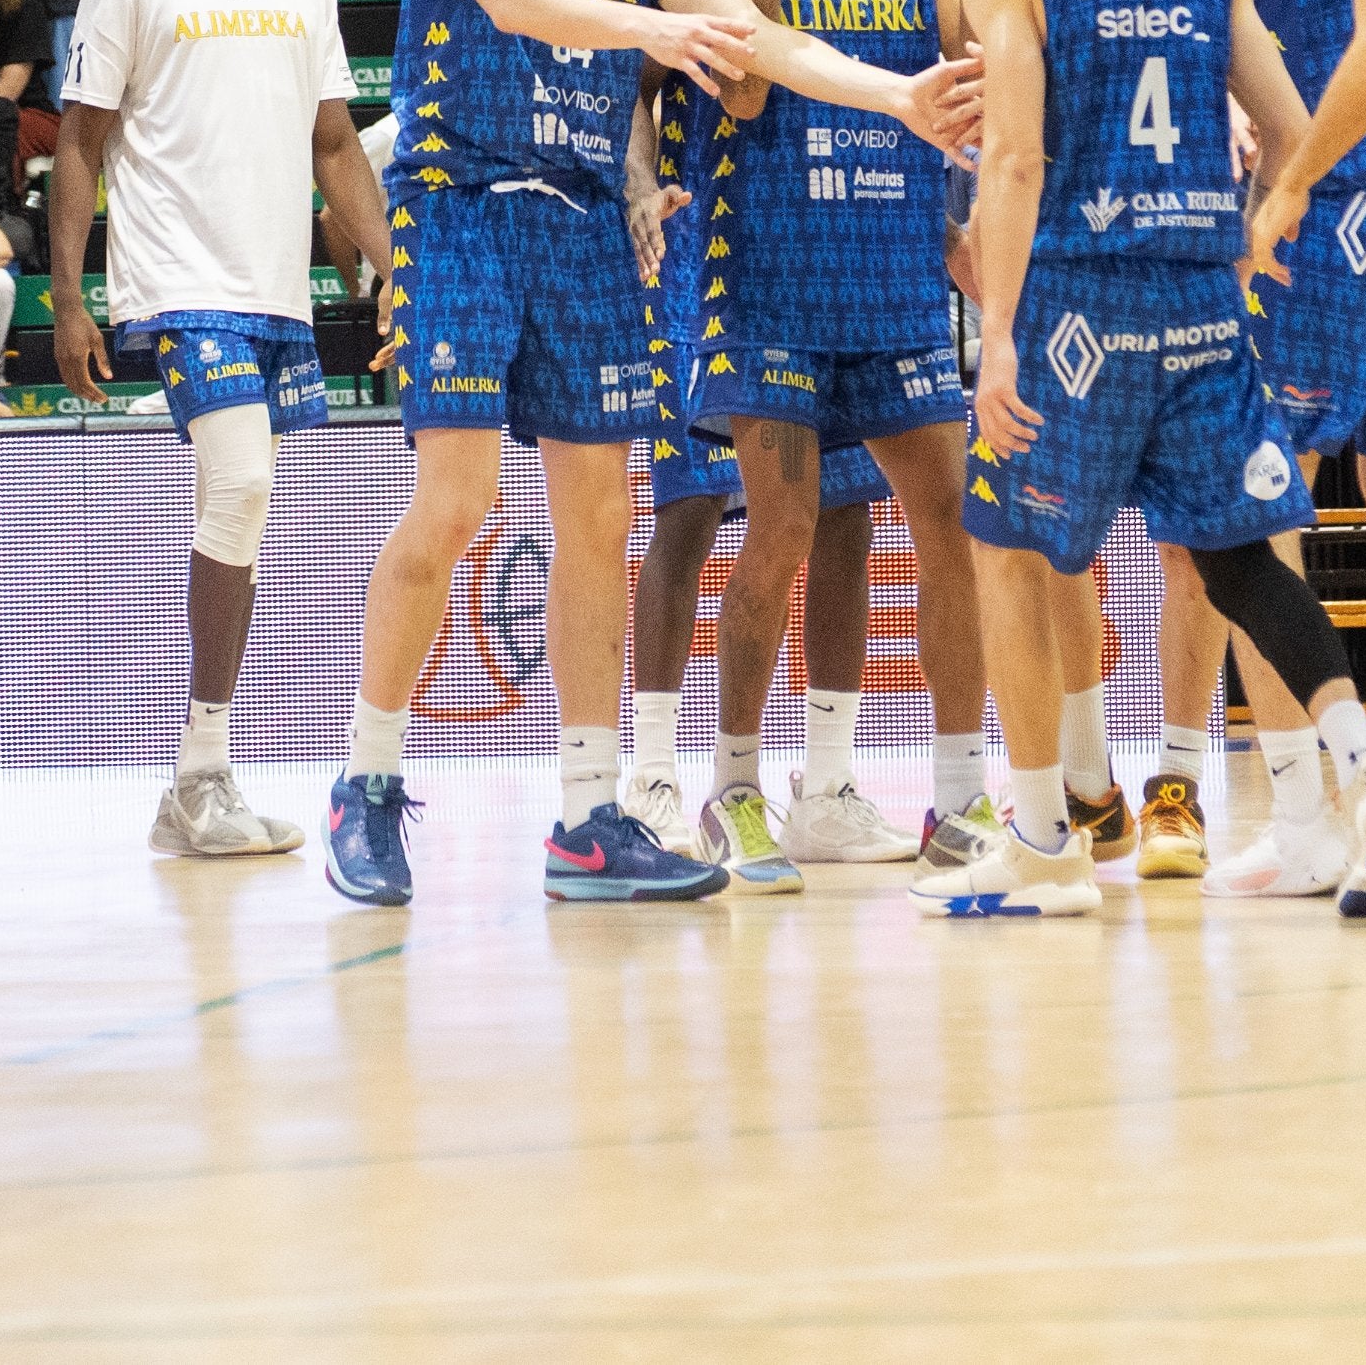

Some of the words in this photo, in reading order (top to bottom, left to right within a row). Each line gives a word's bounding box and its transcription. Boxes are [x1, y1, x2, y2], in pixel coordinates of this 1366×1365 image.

[173, 9, 307, 43] ALIMERKA
[545, 85, 611, 115] OVIEDO
[1129, 55, 1181, 164] 4
[835, 128, 899, 150] OVIEDO
[853, 166, 906, 189] Asturias
[1131, 192, 1183, 212] CAJA
[1186, 190, 1239, 212] RURAL
[1134, 215, 1155, 228] DE
[1156, 214, 1216, 228] ASTURIAS
[310, 279, 343, 295] AJA
[1102, 334, 1160, 353] URIA
[1165, 318, 1240, 347] MOTOR
[431, 377, 501, 394] ALIMERKA
[762, 369, 817, 394] ALIMER
